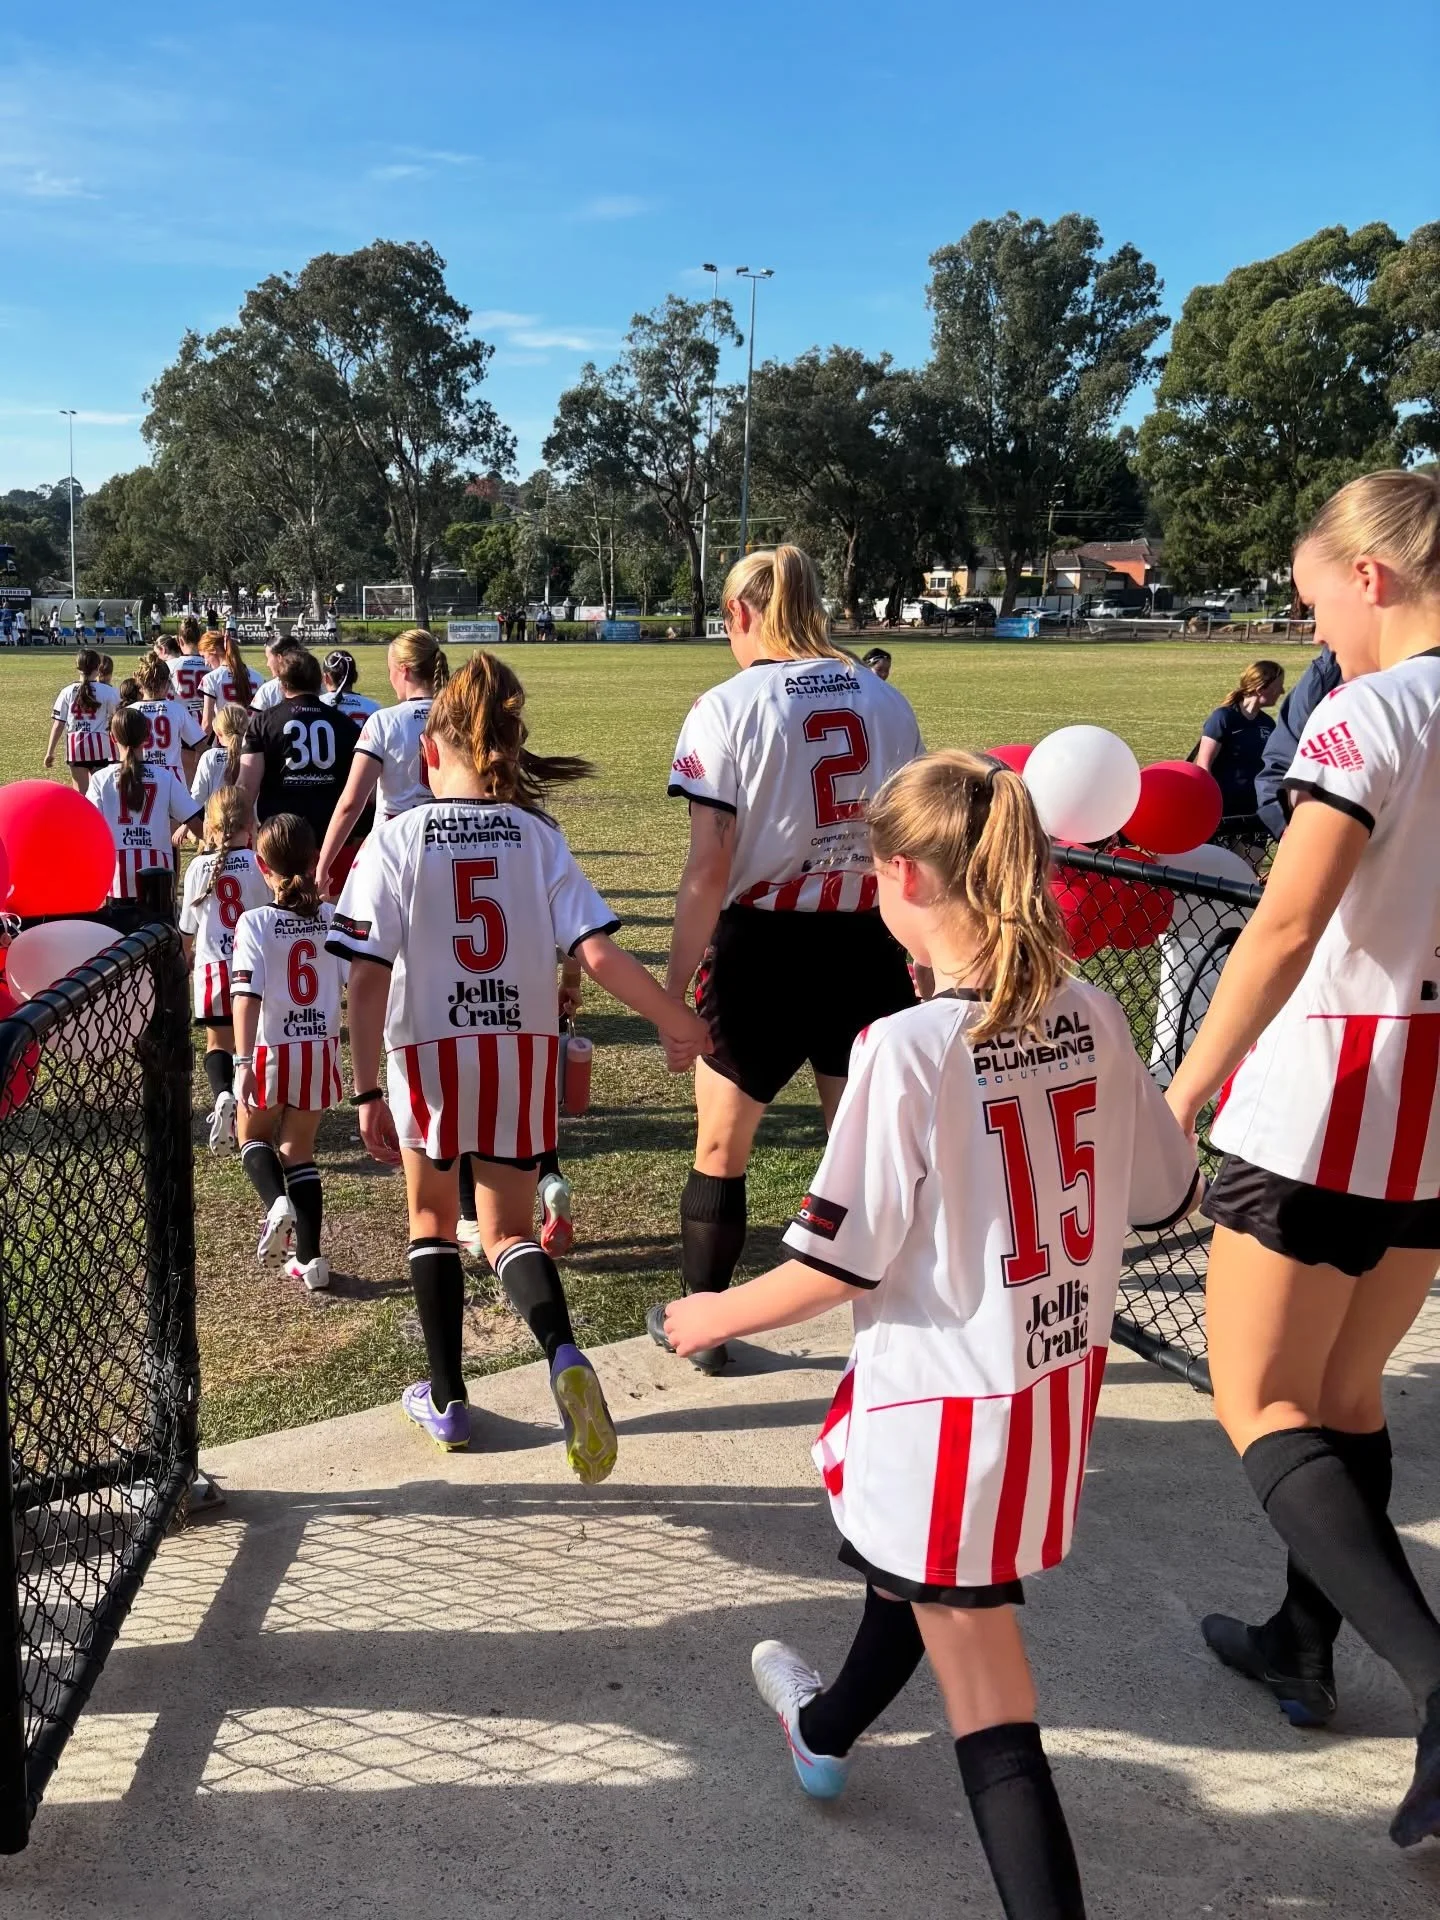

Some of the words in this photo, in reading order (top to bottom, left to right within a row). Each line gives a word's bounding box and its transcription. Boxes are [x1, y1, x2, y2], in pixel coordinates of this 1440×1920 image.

[237, 623, 280, 631] ACTUL
[291, 623, 326, 631] ATUA
[449, 623, 471, 632] Harvey
[472, 623, 498, 632] Norman
[785, 672, 857, 687] ACTUAL
[786, 682, 860, 695] PLUMBING
[283, 719, 336, 771] 30
[1300, 721, 1352, 758] FLEET
[803, 708, 870, 829] 2
[1332, 744, 1354, 770] HIRE
[117, 782, 158, 825] 17
[123, 827, 152, 837] Jellis
[424, 816, 521, 833] ACTUAL
[122, 837, 153, 847] Craig
[425, 831, 522, 845] PLUMBING
[202, 863, 250, 874] PLMBING
[203, 856, 249, 869] ACUAL
[216, 875, 246, 930] 8
[275, 914, 327, 928] ACTUAL
[452, 857, 508, 974] 5
[288, 938, 319, 1006] 6
[448, 979, 519, 1004] Jellis
[284, 1008, 326, 1024] Jellis
[449, 1003, 522, 1032] Craig
[283, 1021, 327, 1039] Craig
[973, 1011, 1091, 1054] ACAL
[973, 1035, 1095, 1075] PLUMBING
[977, 1054, 1096, 1086] SOLUTIONS
[983, 1076, 1098, 1288] 15
[1025, 1279, 1089, 1334] Jellis
[1026, 1312, 1088, 1369] Craig
